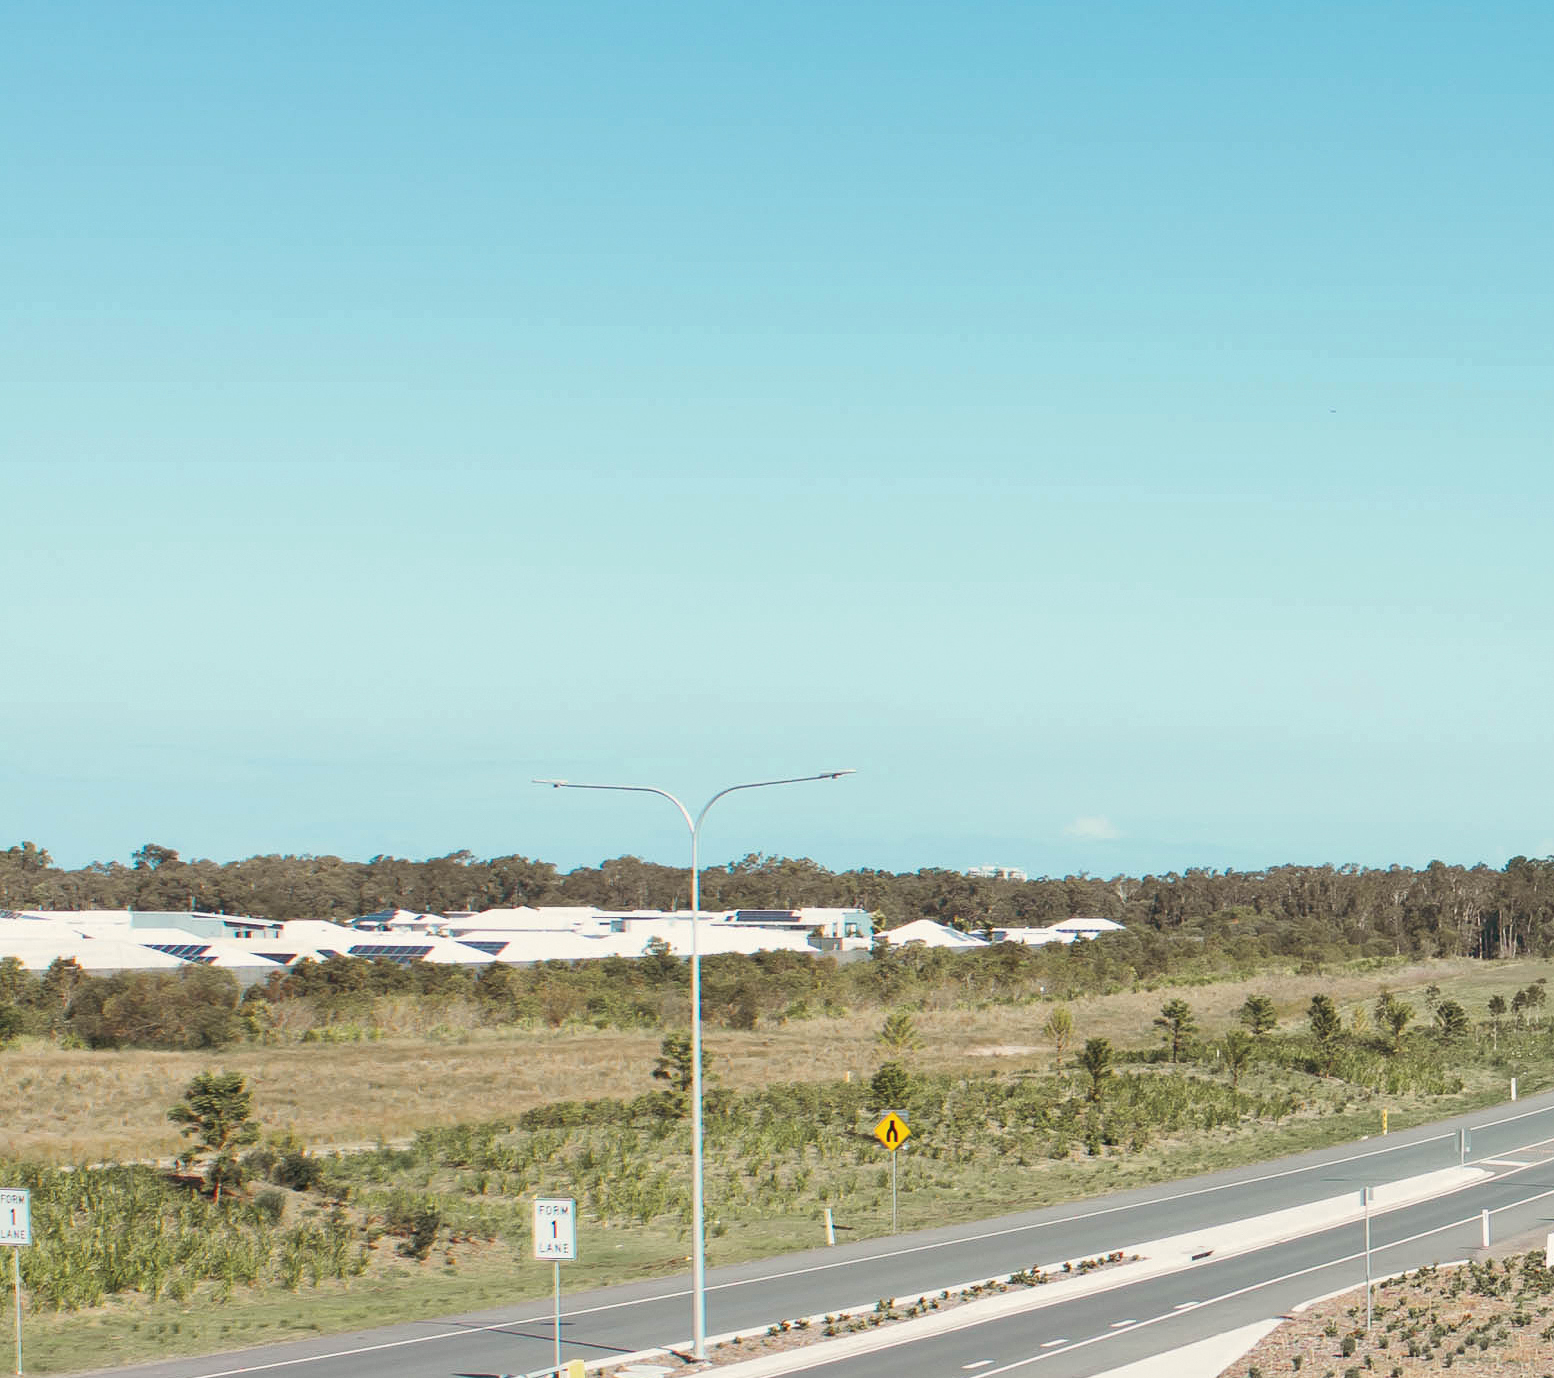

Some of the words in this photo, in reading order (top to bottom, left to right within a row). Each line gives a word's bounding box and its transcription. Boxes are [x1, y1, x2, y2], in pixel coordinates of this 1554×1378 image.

[1, 1194, 25, 1204] FORM
[539, 1205, 569, 1215] FORM
[11, 1208, 16, 1225] 1
[1, 1229, 25, 1239] LANE
[551, 1220, 557, 1238] 1
[539, 1242, 569, 1253] LANE
